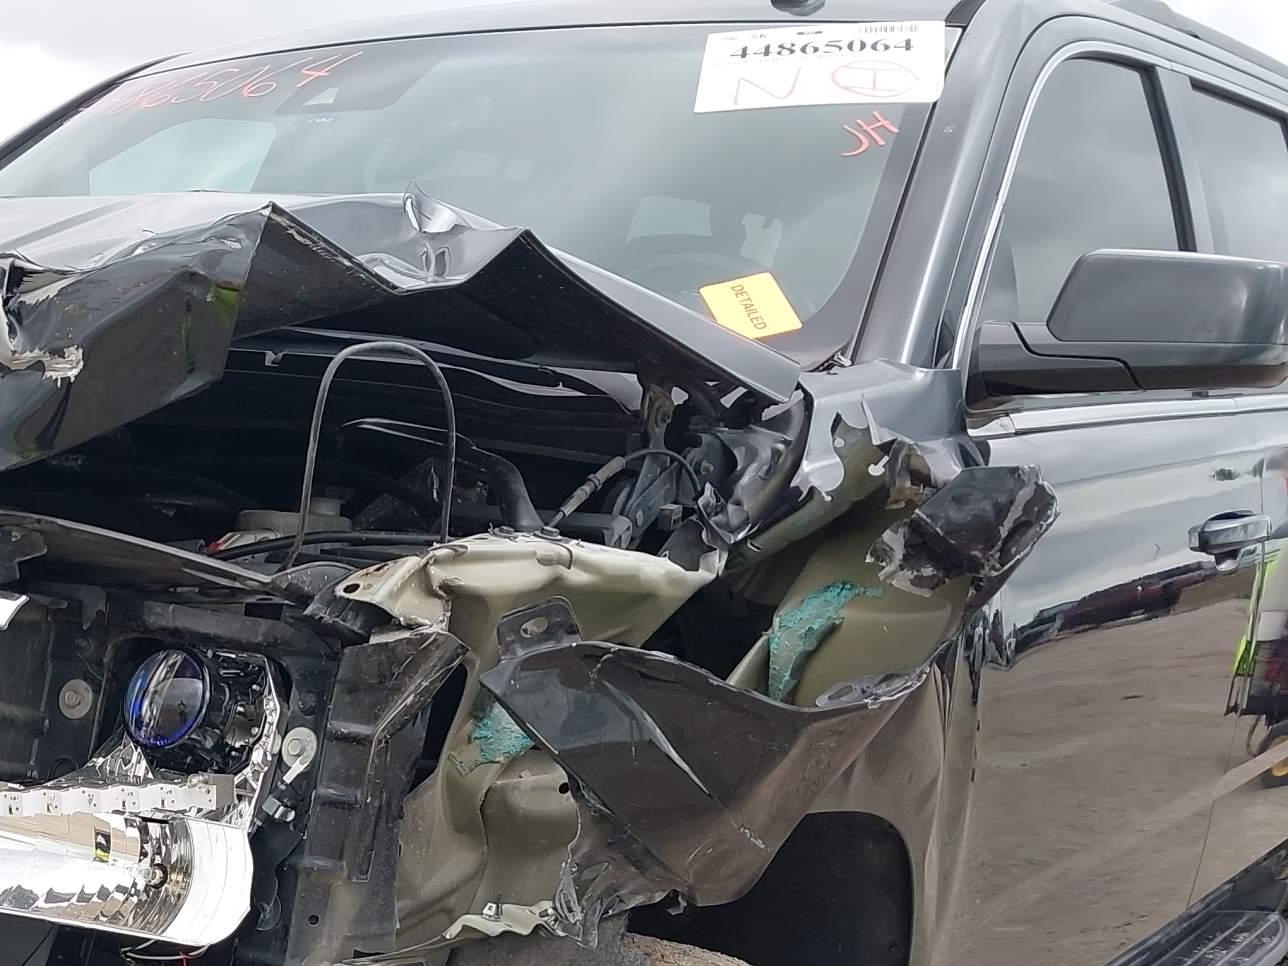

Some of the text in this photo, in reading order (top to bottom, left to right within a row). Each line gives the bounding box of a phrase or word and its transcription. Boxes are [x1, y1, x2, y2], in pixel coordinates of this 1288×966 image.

[730, 38, 914, 59] 44865064
[841, 110, 900, 157] JH
[730, 283, 768, 331] DETAILED
